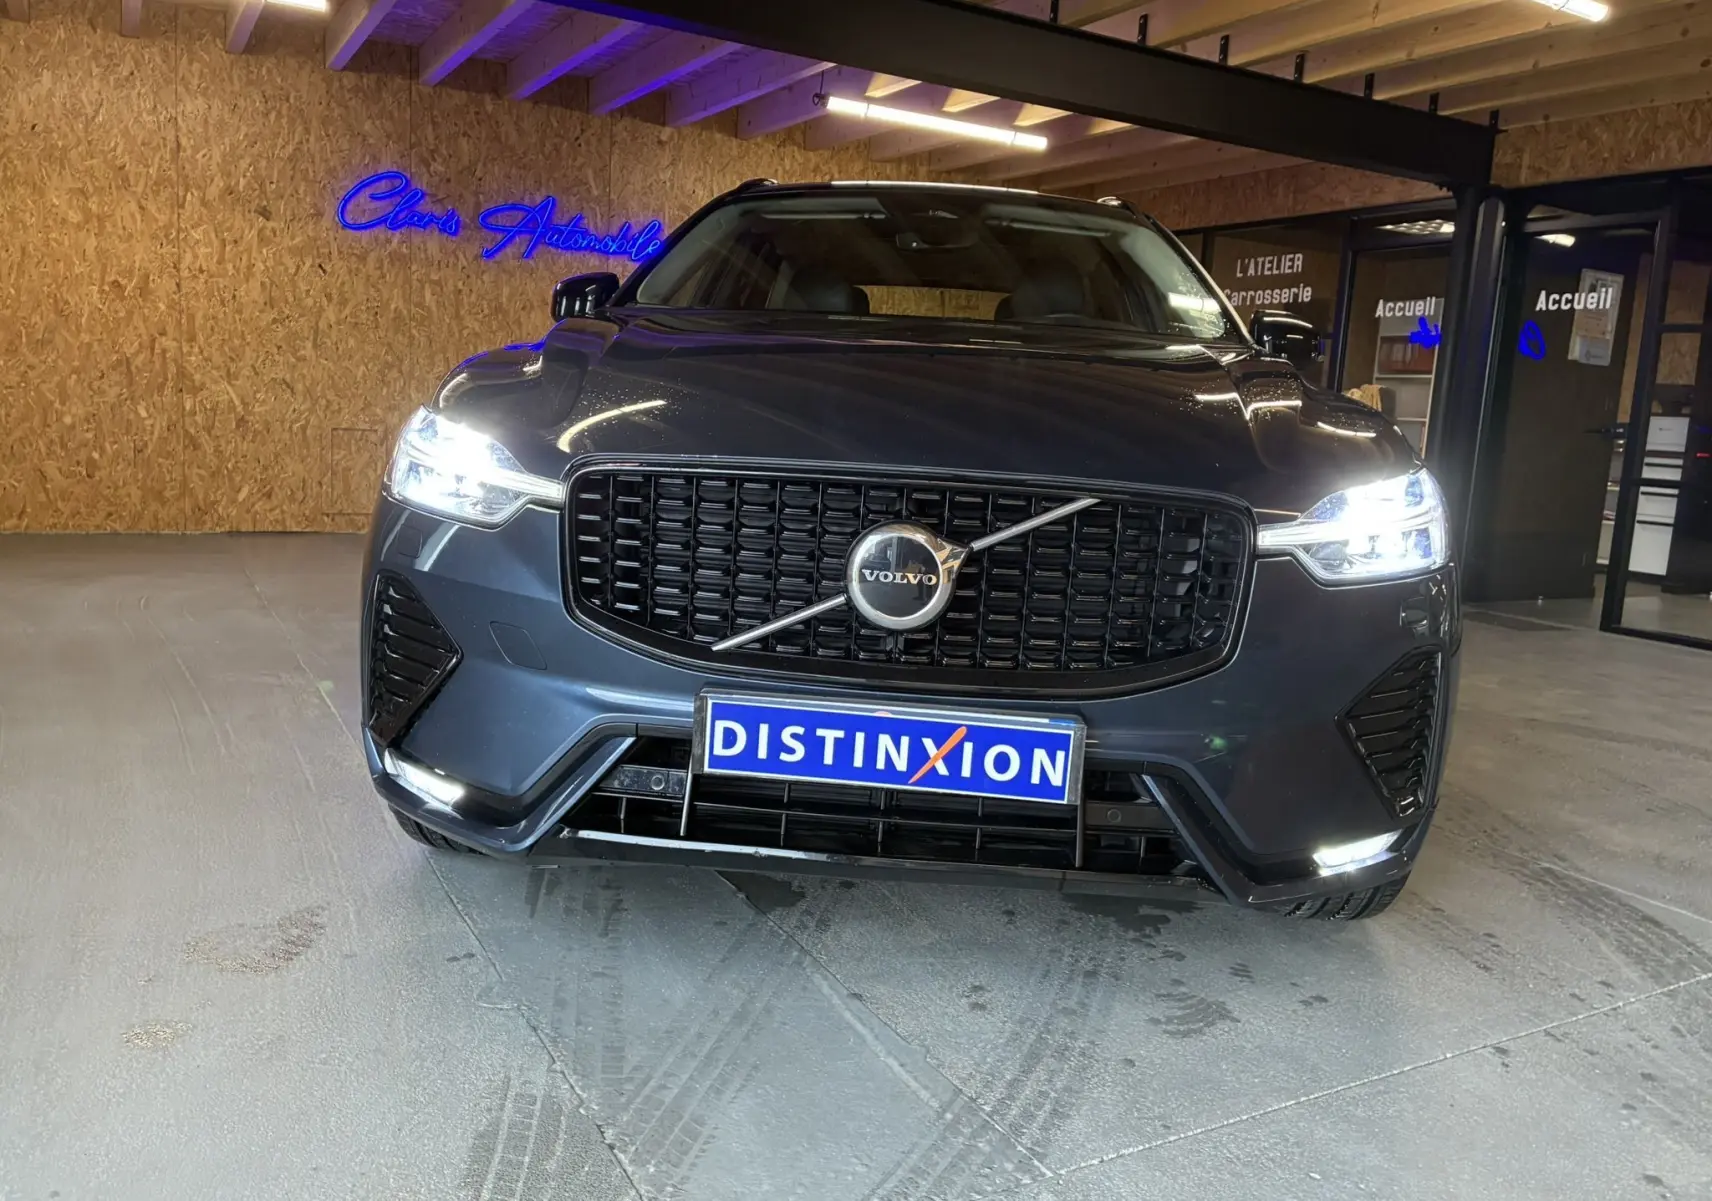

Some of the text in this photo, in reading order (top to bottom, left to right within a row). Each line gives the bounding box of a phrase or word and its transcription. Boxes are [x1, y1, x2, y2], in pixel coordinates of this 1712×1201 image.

[1235, 252, 1304, 278] L'ATELIER
[1375, 296, 1436, 318] Accueil
[1535, 287, 1614, 312] Accueil
[861, 568, 938, 586] VOLVO
[712, 718, 1066, 788] DISTINXION
